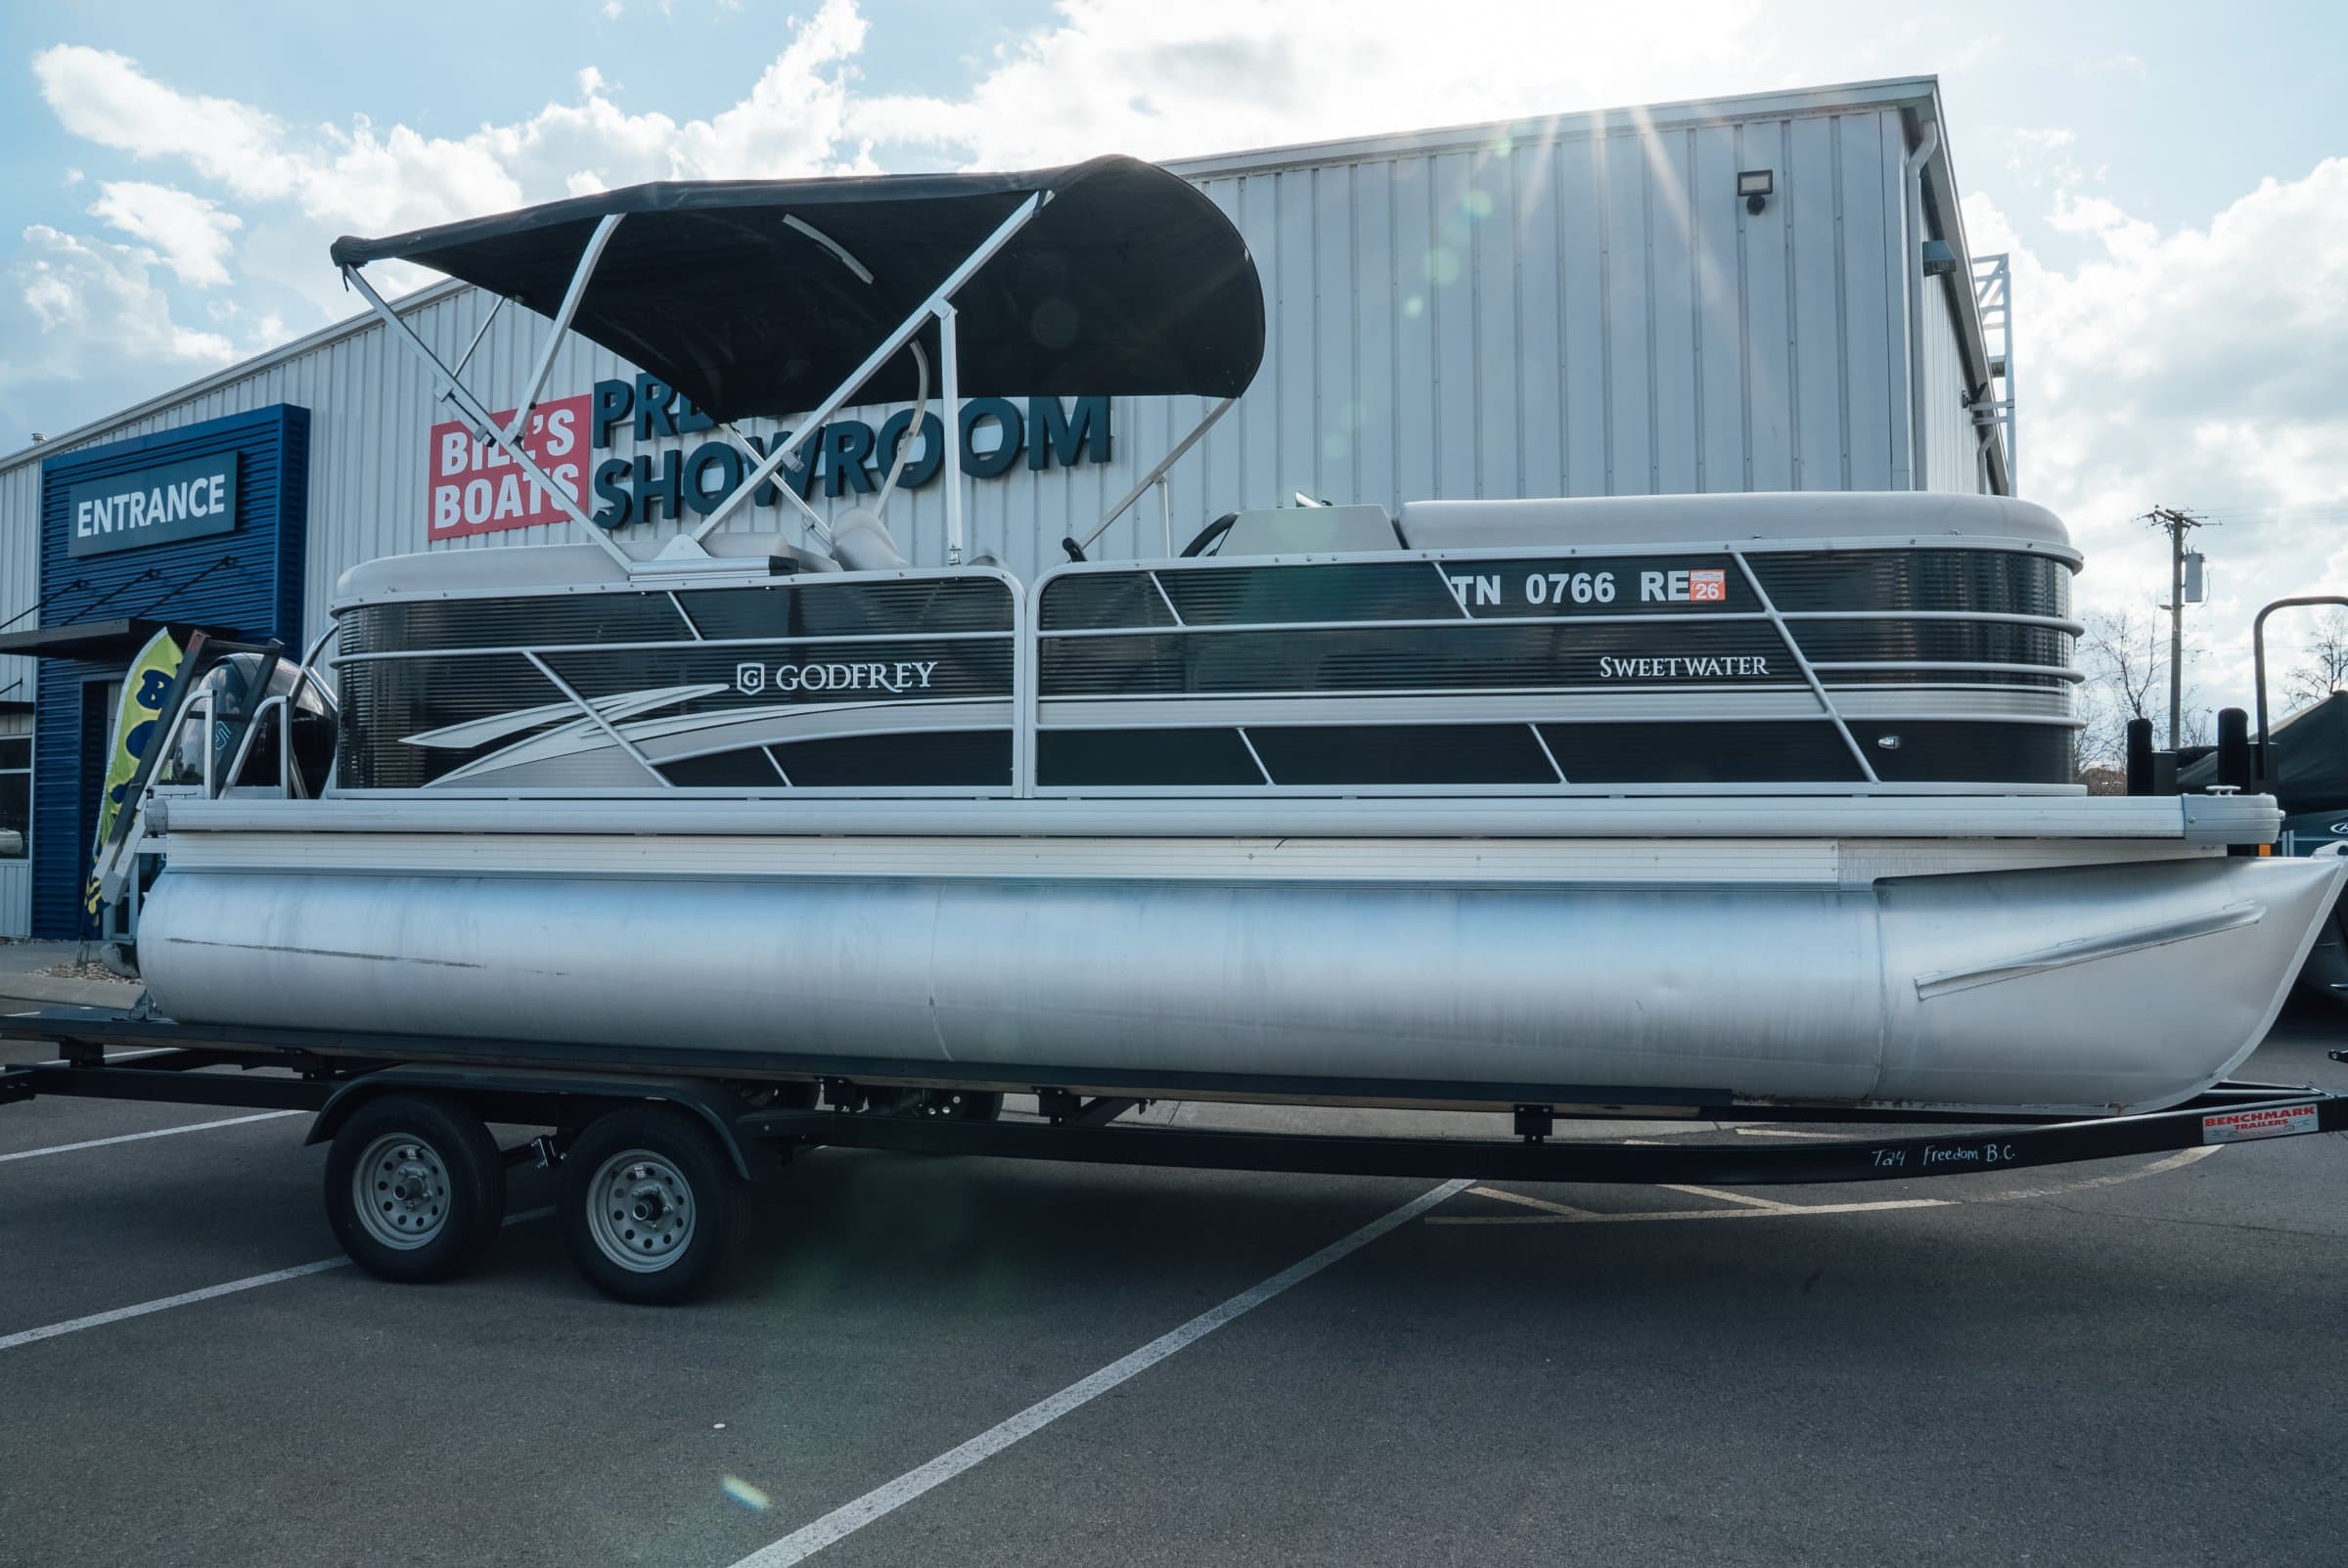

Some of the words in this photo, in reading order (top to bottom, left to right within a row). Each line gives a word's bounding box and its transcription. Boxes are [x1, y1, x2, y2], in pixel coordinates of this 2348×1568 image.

[592, 395, 1112, 530] SHOWROOM
[77, 473, 226, 538] ENTRANCE
[434, 463, 579, 529] BOATS
[1450, 574, 1501, 605] TN
[1525, 572, 1616, 605] 0766
[1640, 570, 1691, 603] RE
[1694, 582, 1720, 600] 26
[776, 661, 938, 694] GODFREY
[2204, 1106, 2315, 1127] BENCHMARK
[2235, 1118, 2289, 1130] TRAILERS
[1922, 1145, 1980, 1167] Freedom
